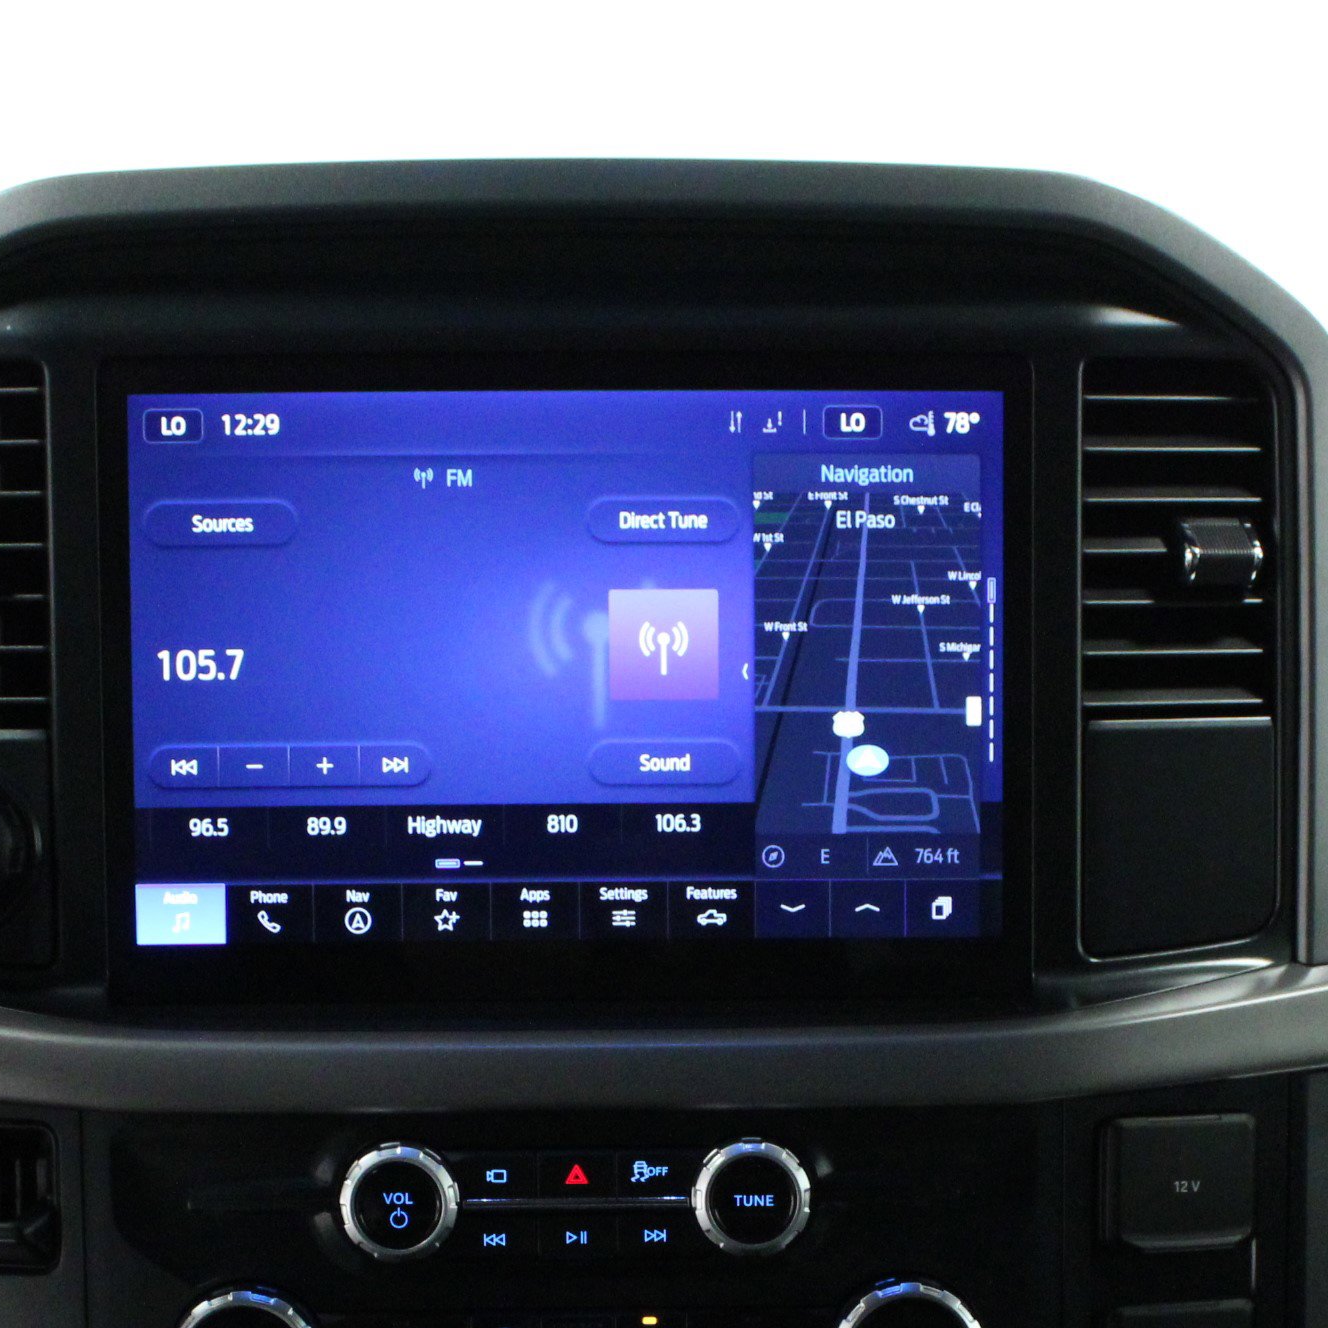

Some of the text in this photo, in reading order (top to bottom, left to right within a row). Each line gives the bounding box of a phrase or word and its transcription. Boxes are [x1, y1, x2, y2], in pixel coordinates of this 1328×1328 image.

[161, 416, 186, 435] LO
[221, 414, 280, 436] 12:29
[840, 414, 866, 432] LO
[446, 469, 473, 488] FM
[821, 464, 914, 485] Navigation
[894, 495, 949, 505] S Chestnut St
[192, 515, 254, 534] Sources
[619, 511, 708, 531] Direct Tune
[836, 511, 895, 529] El Paso
[948, 571, 959, 580] W
[891, 594, 951, 605] W Jefferson St
[764, 622, 808, 632] W Front St
[939, 643, 946, 652] S
[157, 649, 244, 681] 105.7
[639, 754, 691, 773] Sound
[189, 818, 229, 838] 96.5
[307, 817, 347, 837] 89.9
[407, 816, 482, 838] Highway
[547, 814, 578, 834] 810
[655, 814, 702, 834] 106.3
[820, 848, 831, 864] E
[915, 847, 960, 865] 764 ft
[250, 890, 289, 903] Phone
[345, 889, 370, 903] Nav
[435, 888, 458, 902] Fav
[520, 887, 550, 903] Apps
[599, 887, 648, 902] Settings
[686, 886, 737, 900] Features
[647, 1166, 669, 1177] OFF
[1174, 1180, 1200, 1193] 12 V
[383, 1192, 413, 1206] VOL
[734, 1194, 775, 1208] TUNE
